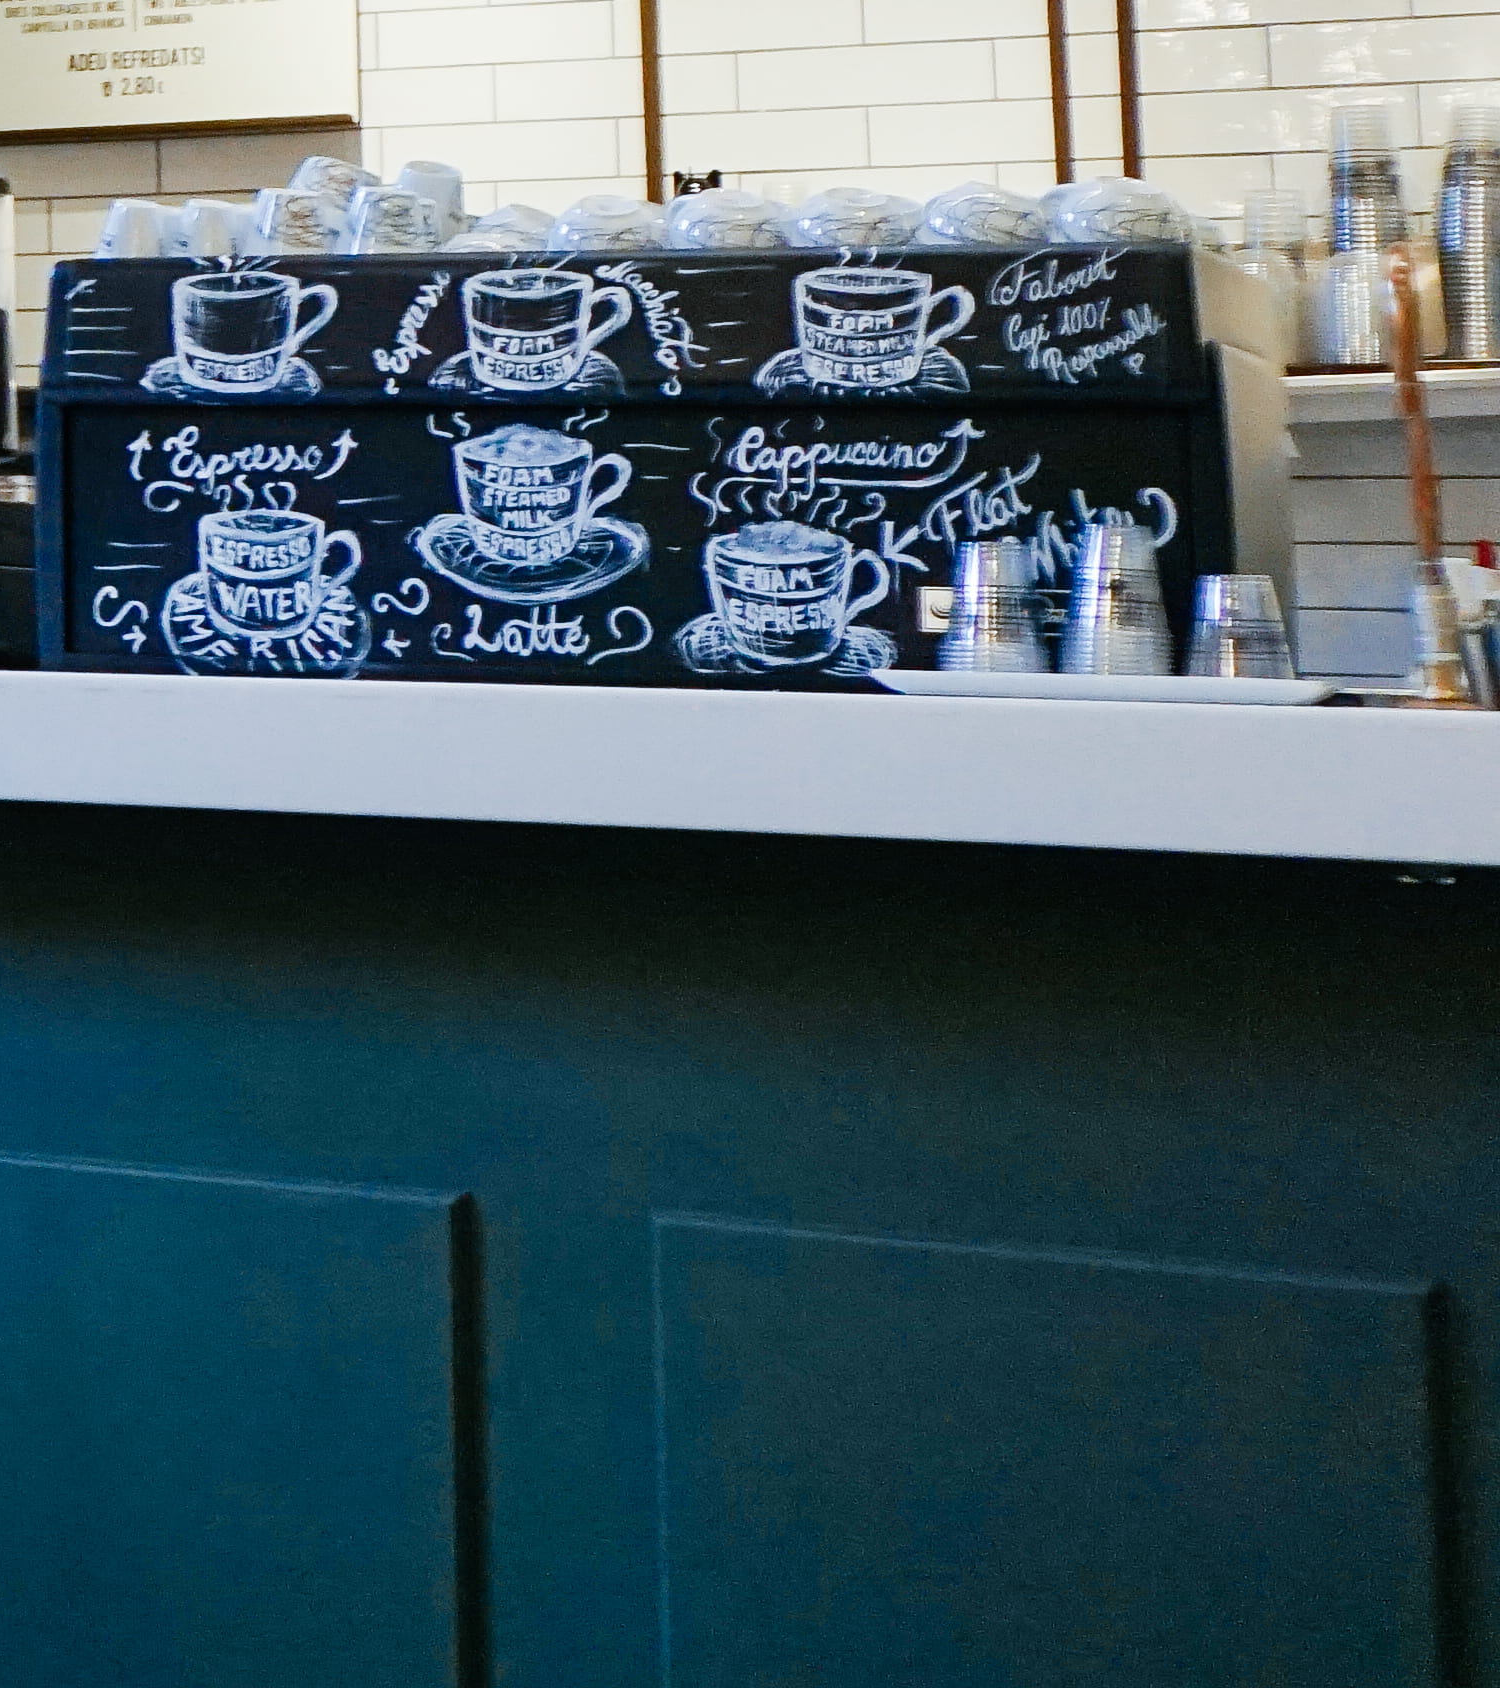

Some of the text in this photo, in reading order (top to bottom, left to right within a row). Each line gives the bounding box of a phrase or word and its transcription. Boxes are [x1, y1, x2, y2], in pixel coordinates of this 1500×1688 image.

[828, 313, 895, 332] FOAM
[492, 335, 556, 354] FOAM
[482, 354, 574, 382] ESPRESSO
[162, 425, 324, 496] Espresso
[484, 463, 555, 487] FOAM
[729, 425, 949, 501] Cappuccino
[482, 486, 571, 507] STEAMED
[925, 452, 1042, 556] Flat
[501, 510, 556, 529] MILK
[210, 535, 312, 570] ESPRESSO
[736, 564, 815, 593] FOAM
[216, 580, 313, 622] WATER
[728, 595, 841, 636] ESPRESSO
[462, 604, 591, 657] Latte
